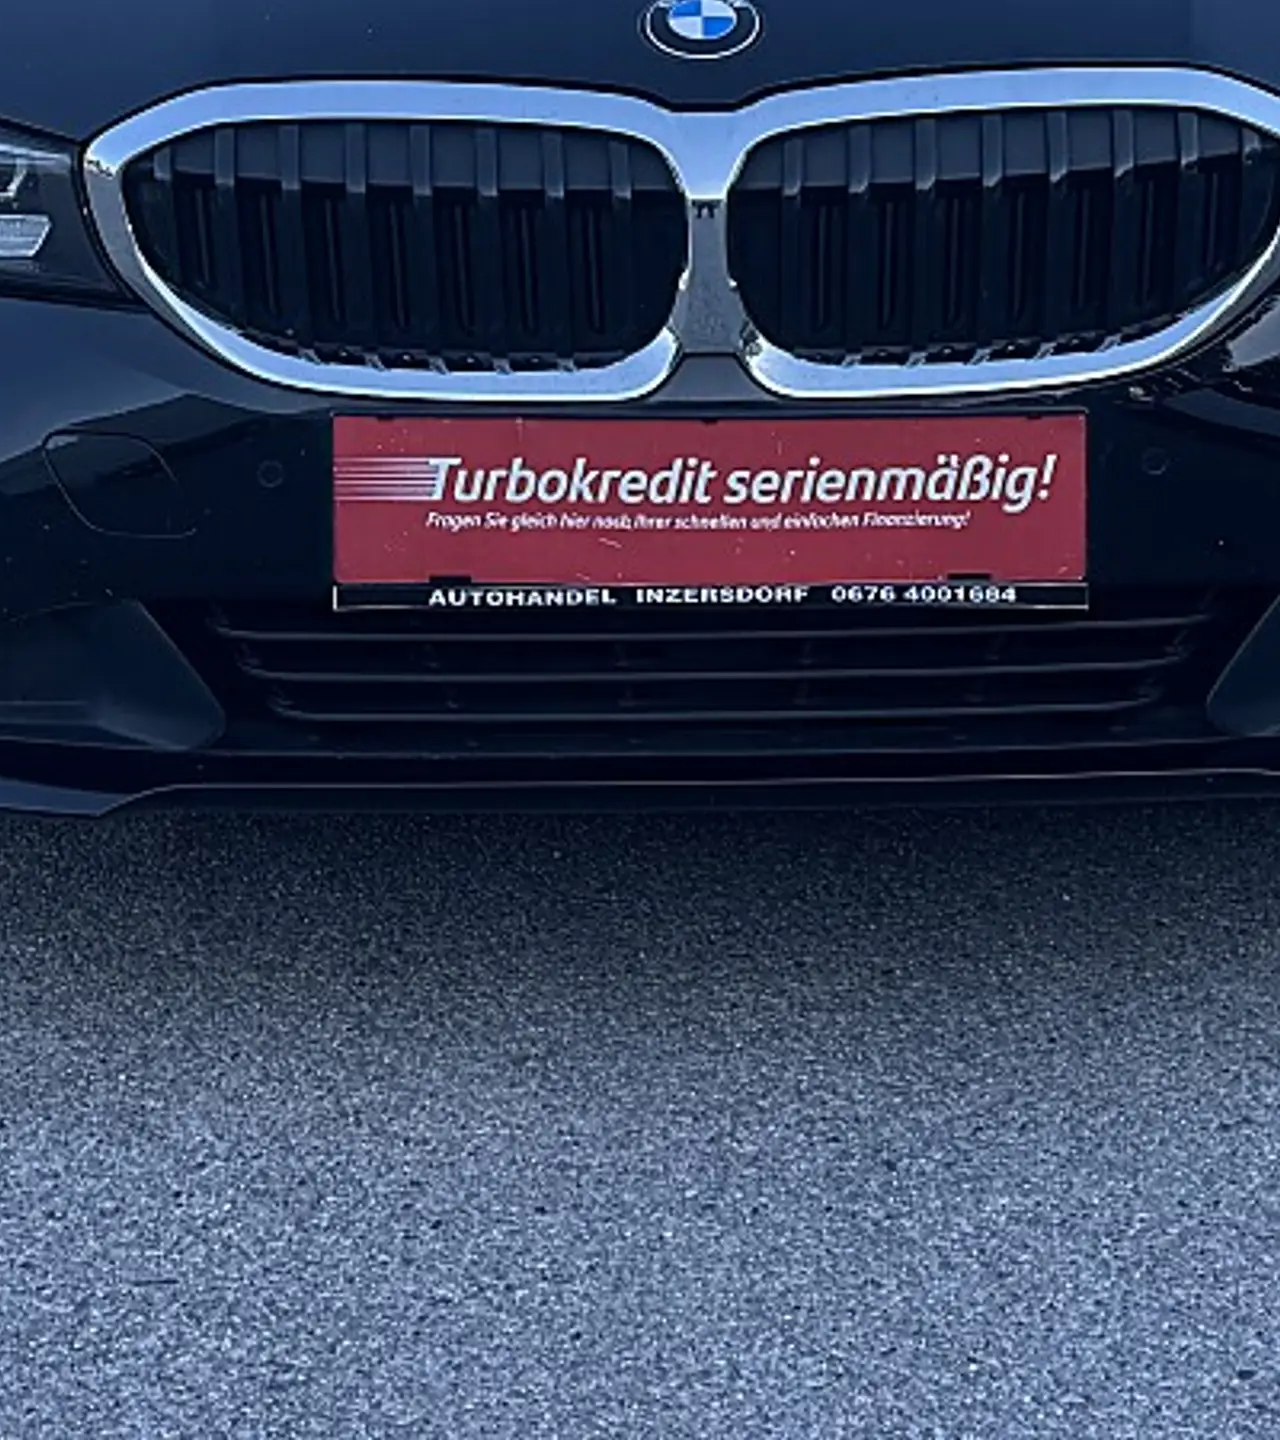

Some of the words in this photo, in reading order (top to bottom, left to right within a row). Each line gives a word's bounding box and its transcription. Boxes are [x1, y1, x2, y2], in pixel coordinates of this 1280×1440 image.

[427, 456, 718, 503] Turbokredit
[723, 453, 1058, 513] serienmäßig!
[425, 512, 482, 532] Fragen
[484, 511, 508, 529] Sie
[511, 511, 557, 532] gleich
[560, 512, 590, 529] hier
[674, 513, 747, 530] schnellen
[749, 513, 781, 531] und
[783, 511, 859, 528] einfachen
[862, 509, 971, 529] Finanzierung!
[428, 588, 617, 607] AUTOHANDEL
[636, 585, 809, 604] INZERSDORF
[830, 585, 896, 604] 0676
[903, 585, 1018, 604] 4001684
